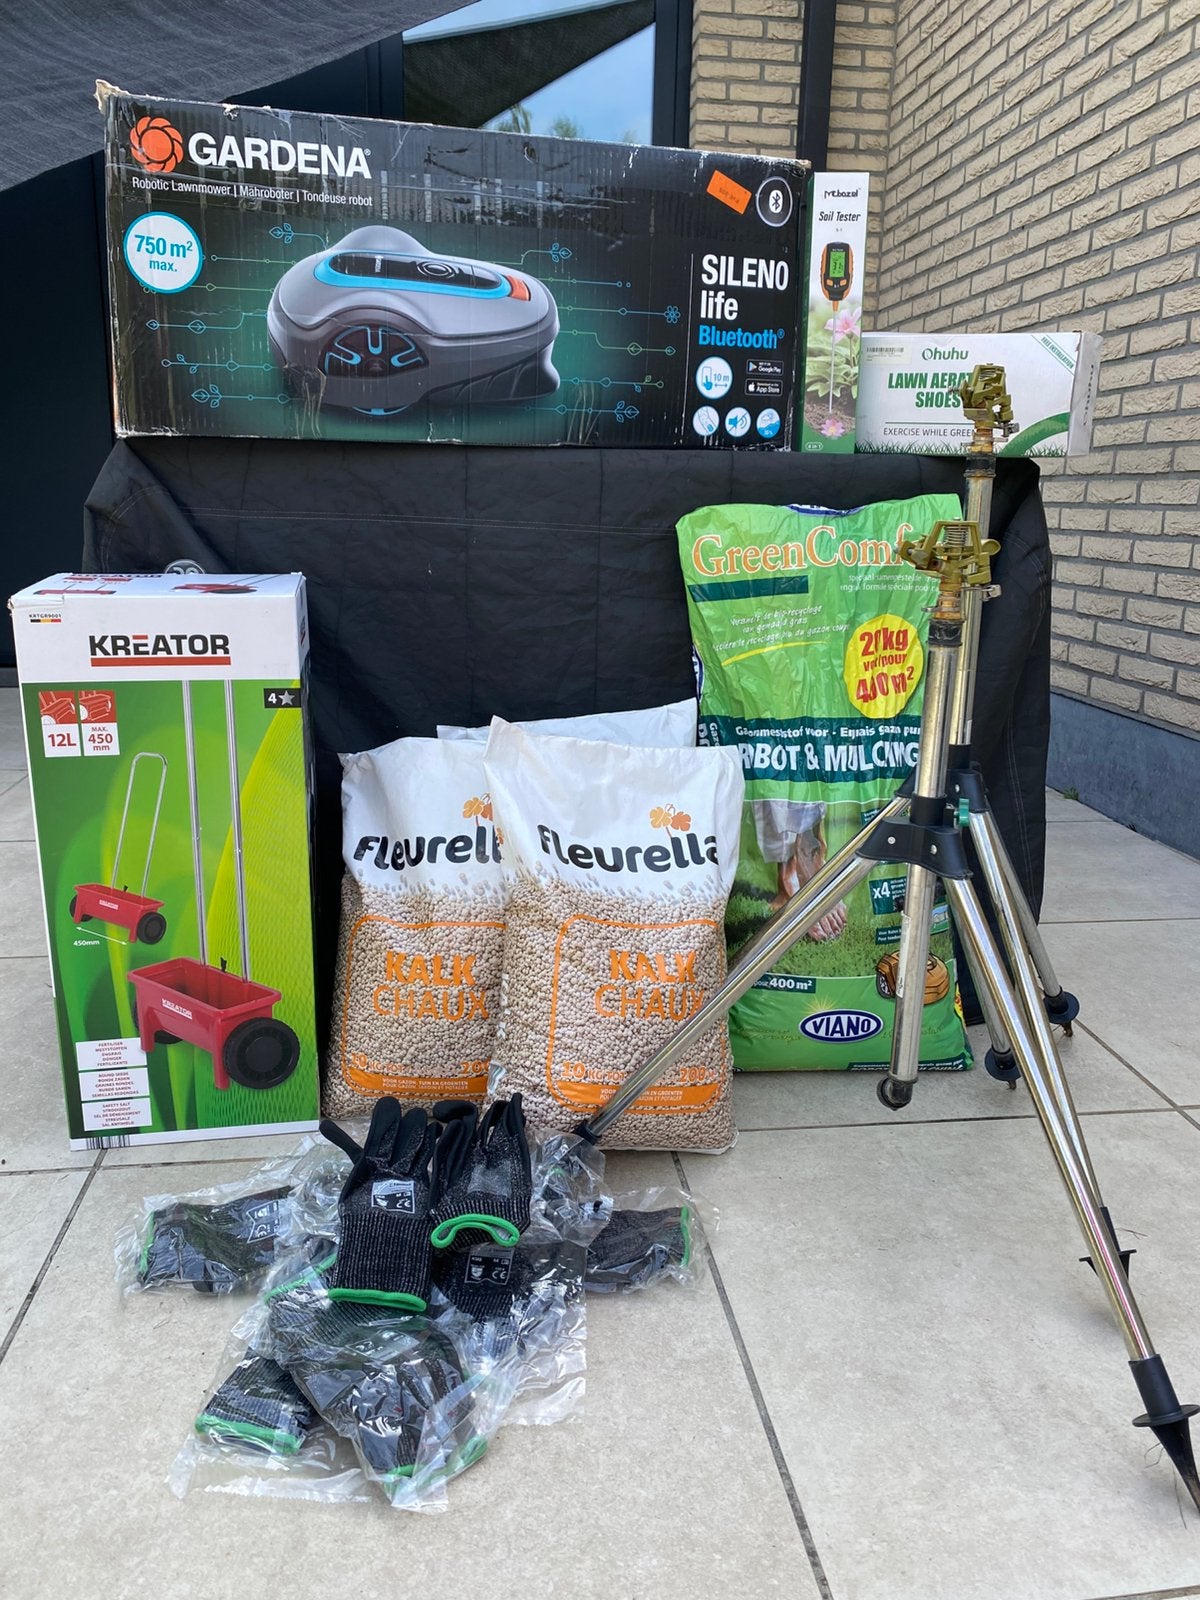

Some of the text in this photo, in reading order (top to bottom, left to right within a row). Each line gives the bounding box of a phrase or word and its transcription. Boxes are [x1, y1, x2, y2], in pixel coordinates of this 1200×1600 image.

[132, 176, 169, 192] Robotic
[171, 180, 231, 197] Lawnmower
[239, 186, 294, 203] Mähroboter
[302, 190, 347, 205] Tondeuse
[348, 194, 373, 208] robot
[819, 211, 862, 222] Soil Tester
[134, 234, 167, 257] 750
[149, 258, 178, 273] max.
[702, 254, 790, 294] SILENO
[700, 290, 739, 321] life
[921, 347, 969, 362] Ohuhu
[714, 373, 722, 383] 10
[887, 372, 974, 390] LAWN AERAT
[915, 391, 961, 409] SHOES
[883, 428, 921, 438] EXERCISE
[922, 429, 948, 438] WHILE
[88, 634, 230, 657] KREATOR
[267, 692, 277, 704] 4
[47, 733, 77, 747] 12L
[88, 733, 113, 744] 450
[738, 742, 801, 771] RBOT
[803, 742, 820, 771] &
[353, 825, 502, 871] Fleurell
[537, 824, 719, 873] Fleurella
[872, 881, 891, 899] x4
[385, 950, 476, 986] KALK
[608, 948, 697, 984] KALK
[769, 977, 796, 990] 400
[372, 984, 490, 1022] CHAUX
[594, 983, 706, 1022] CHAUX
[811, 1015, 873, 1038] VIANO
[350, 1053, 367, 1069] 10
[562, 1060, 586, 1079] 10
[587, 1070, 602, 1081] KG
[679, 1066, 706, 1083] 200
